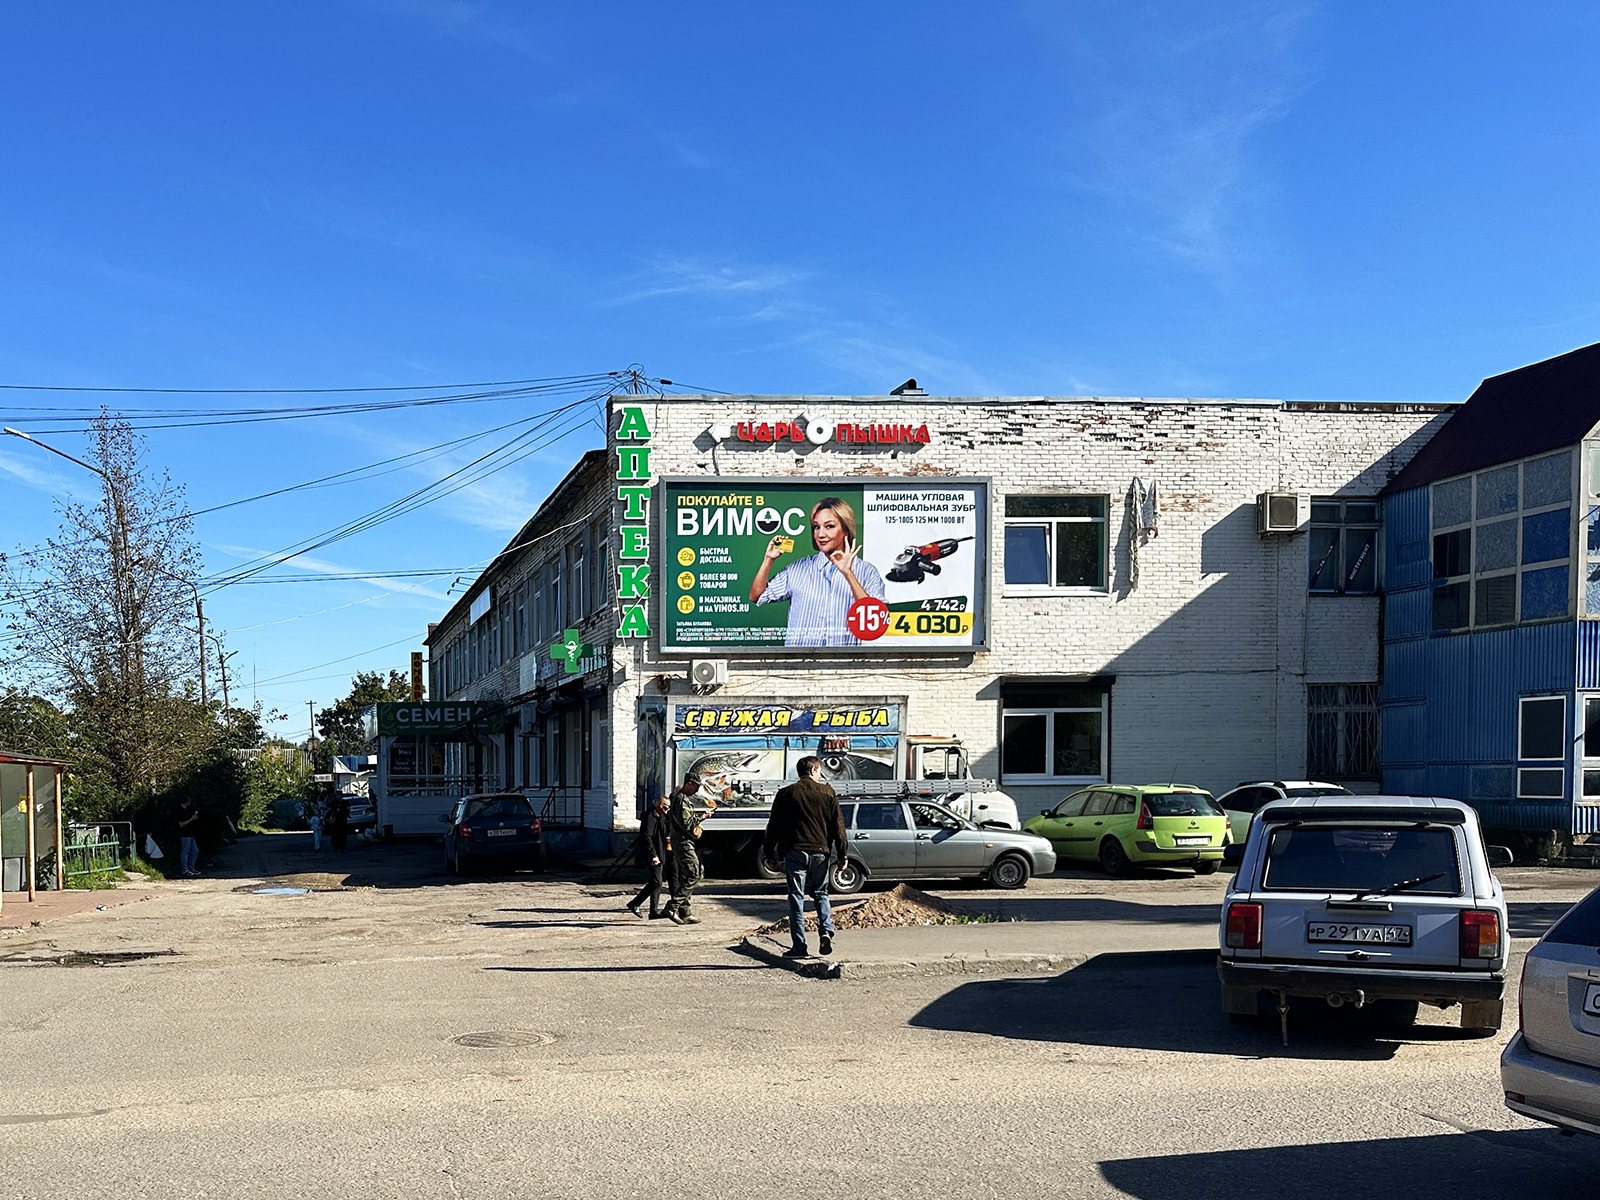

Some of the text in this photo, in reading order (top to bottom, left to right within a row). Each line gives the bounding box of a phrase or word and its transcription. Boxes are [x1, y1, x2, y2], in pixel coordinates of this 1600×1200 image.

[737, 421, 931, 443] ЦАРЬ ПЫШКА
[677, 493, 765, 506] ПОКУПАЙТЕ В
[876, 493, 965, 501] МАШИНА УГЛОВАЯ
[867, 504, 976, 512] ШЛИФОВАЛЬНАЯ ЗУБР
[616, 407, 652, 638] АПТЕКА
[677, 507, 806, 536] ВИМОС
[915, 516, 926, 524] 125
[927, 516, 939, 524] ММ
[940, 516, 956, 524] 1000
[956, 516, 965, 524] ВТ
[700, 547, 729, 555] БЫСТРАЯ
[700, 556, 732, 564] ДОСТАВКА
[700, 573, 719, 581] БОЛЕЕ
[719, 573, 727, 581] 50
[699, 596, 741, 604] В МАГАЗИНАХ
[713, 604, 750, 613] VIMOS.RU
[848, 605, 891, 631] -15%
[895, 615, 910, 633] 4
[684, 710, 889, 727] СВЕЖАЯ РЫБА
